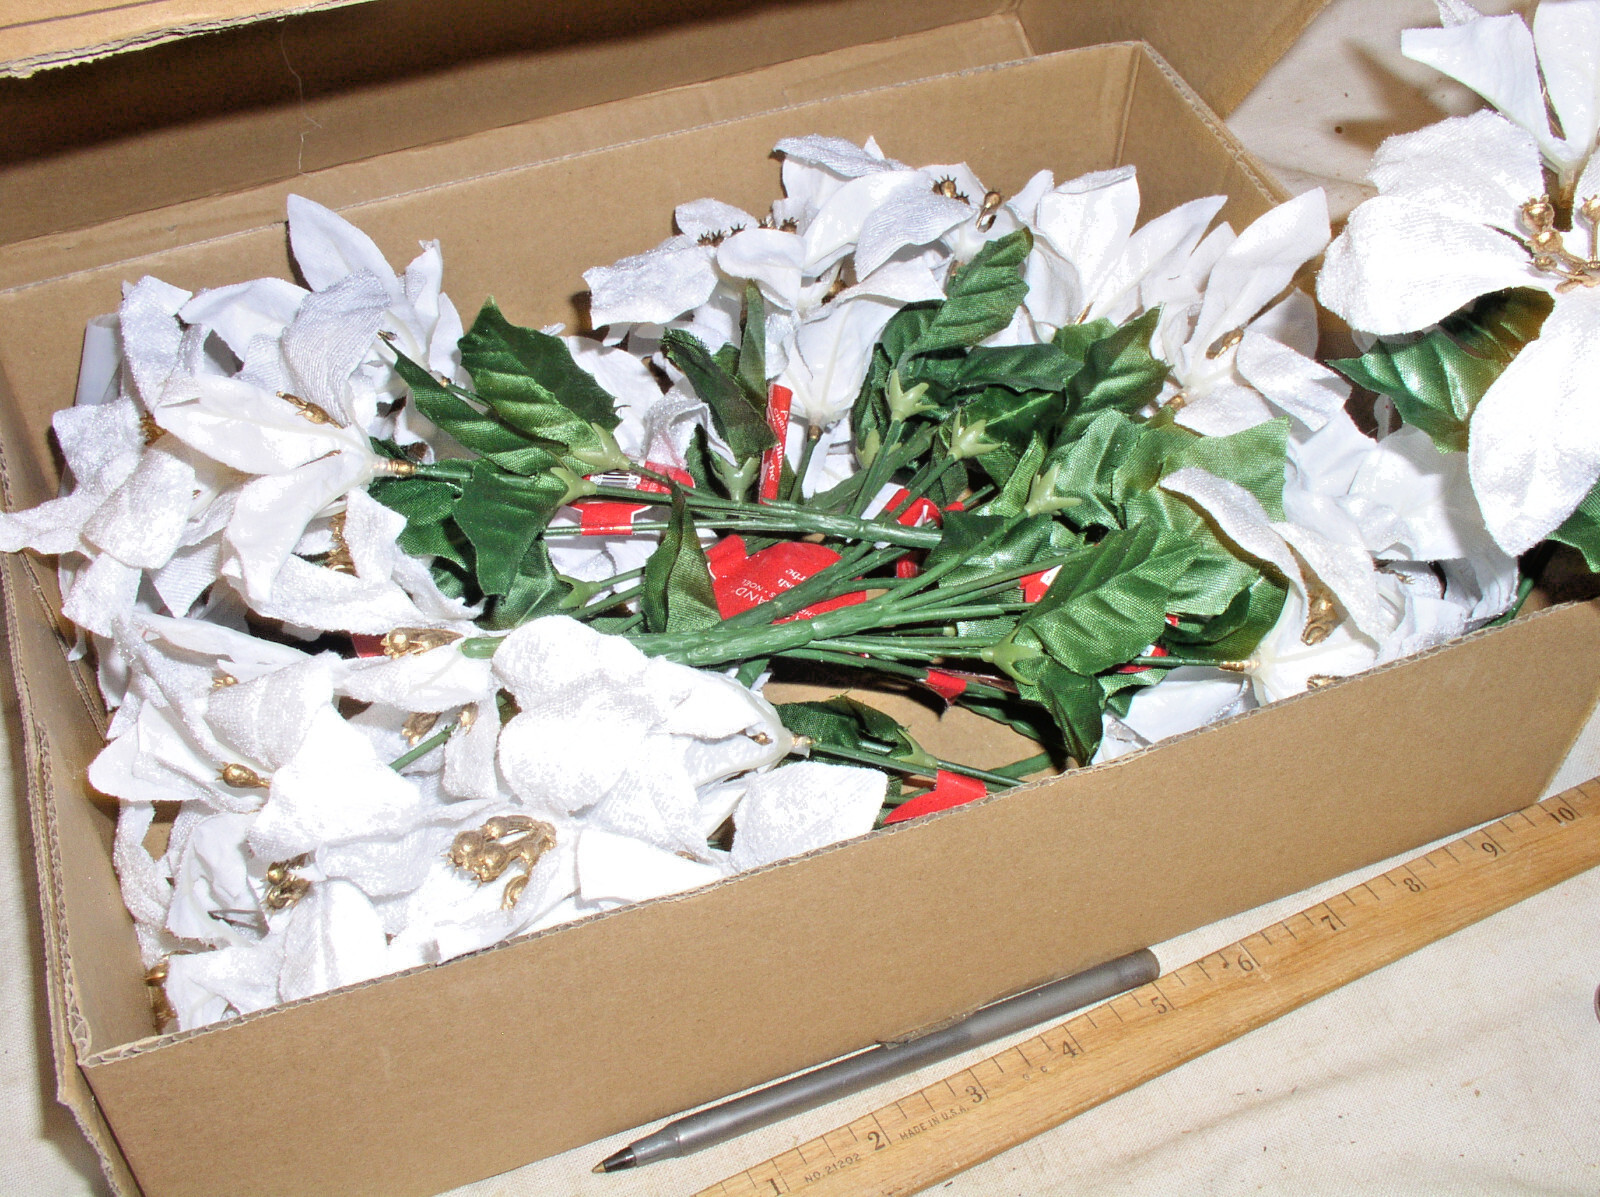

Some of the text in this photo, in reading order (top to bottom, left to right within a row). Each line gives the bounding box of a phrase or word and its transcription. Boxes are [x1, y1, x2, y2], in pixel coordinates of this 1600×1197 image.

[1547, 807, 1576, 824] 10
[1481, 842, 1498, 858] 9
[1403, 878, 1421, 894] 8
[1321, 915, 1338, 932] 7
[1237, 954, 1254, 973] 6
[1150, 996, 1168, 1014] 5
[1062, 1040, 1078, 1059] 4
[965, 1085, 983, 1104] 3
[899, 1122, 928, 1141] MADE
[927, 1115, 941, 1128] IN
[867, 1131, 886, 1151] 2
[765, 1178, 784, 1197] 1
